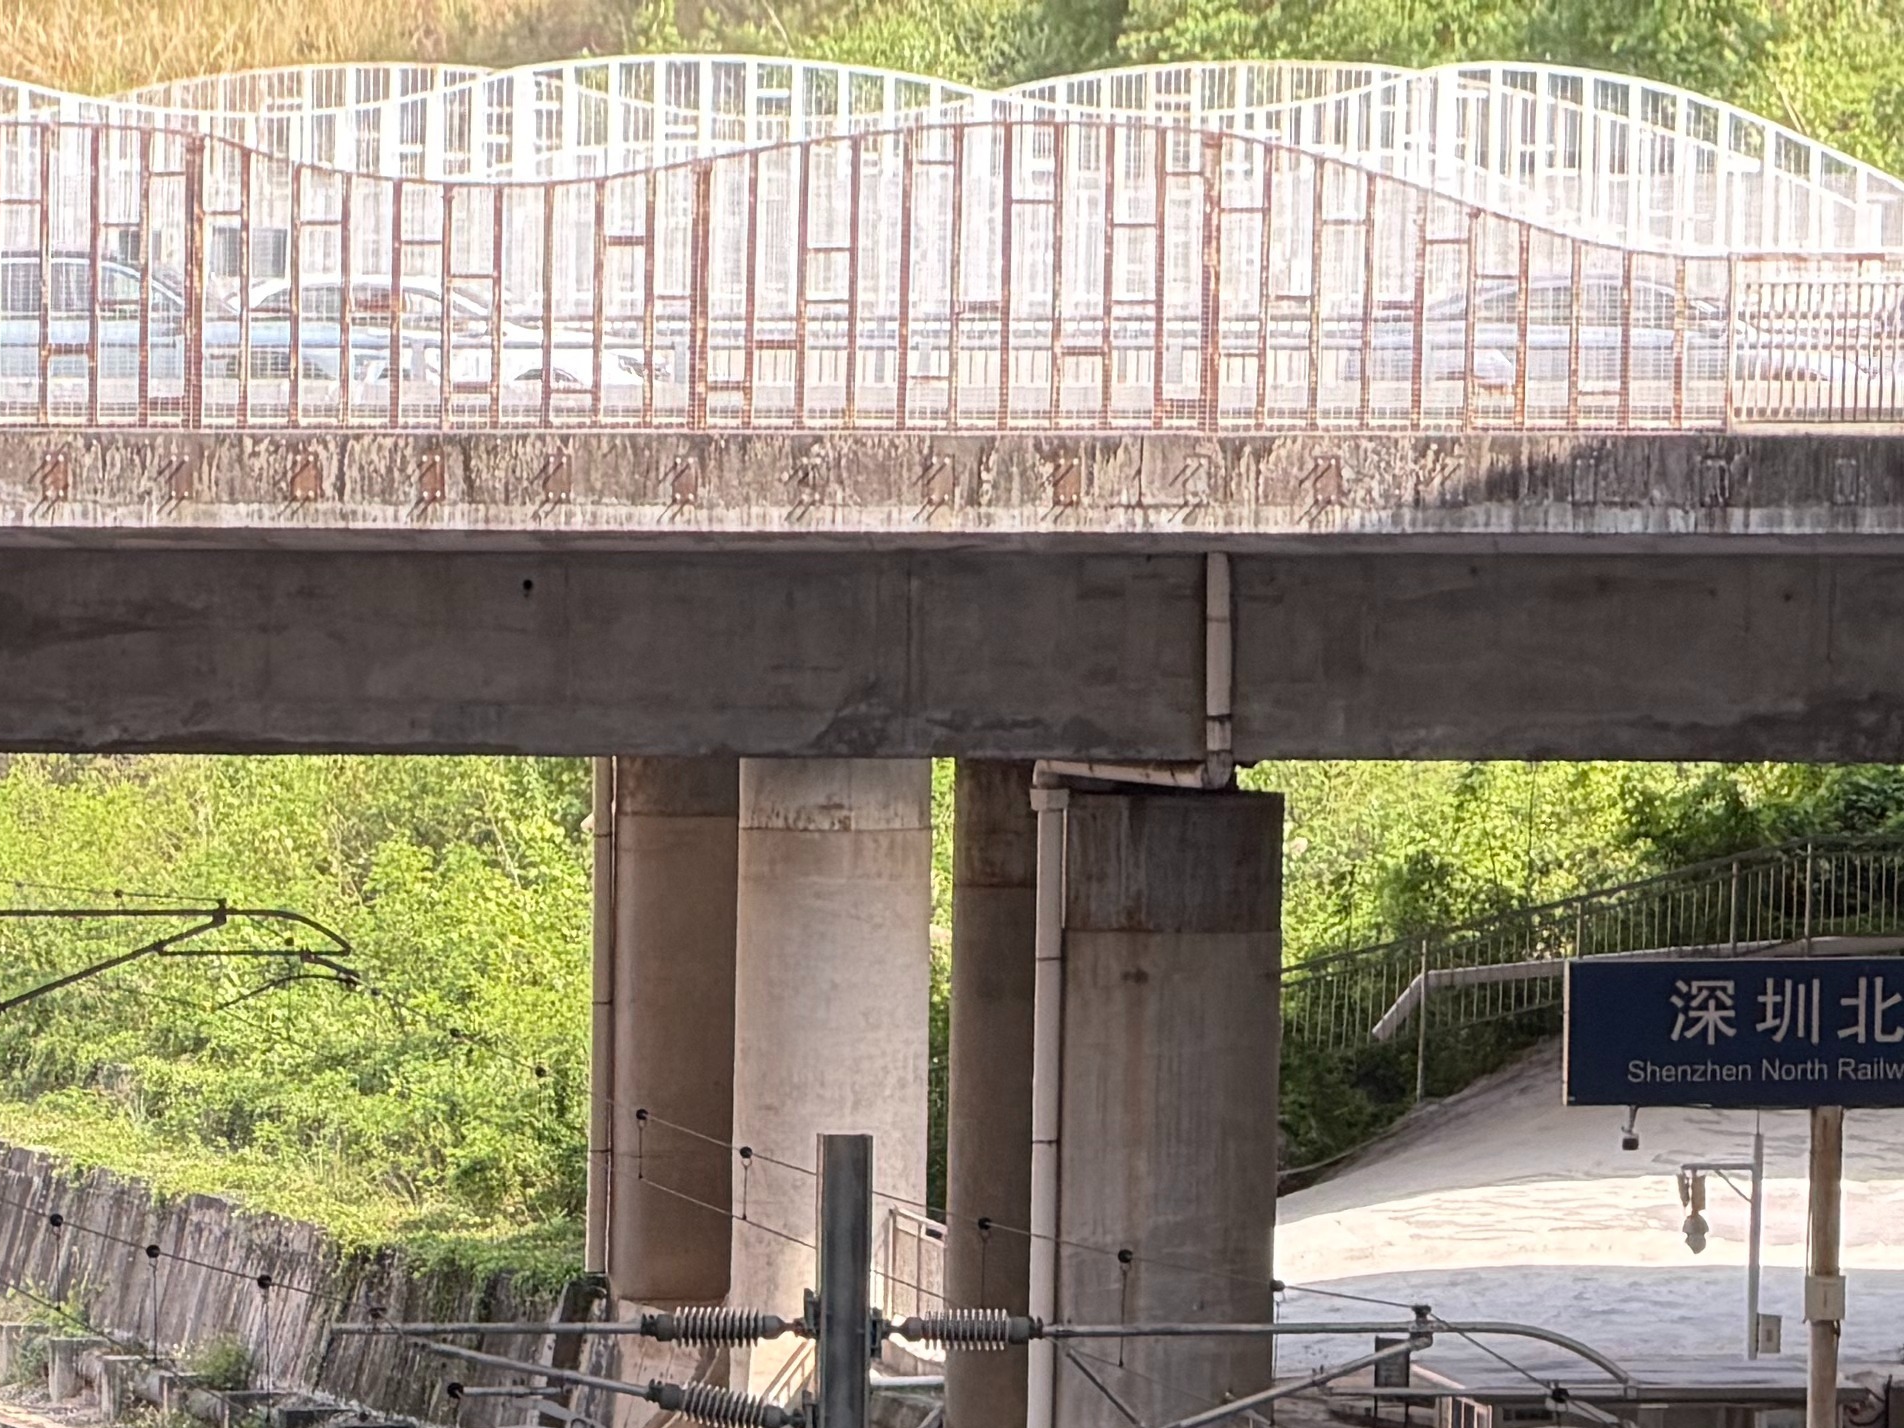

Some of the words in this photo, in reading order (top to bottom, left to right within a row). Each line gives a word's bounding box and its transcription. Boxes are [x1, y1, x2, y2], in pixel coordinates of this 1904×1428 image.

[1669, 976, 1904, 1046] 深圳北
[1627, 1059, 1752, 1083] Shenzhen
[1761, 1059, 1829, 1082] North
